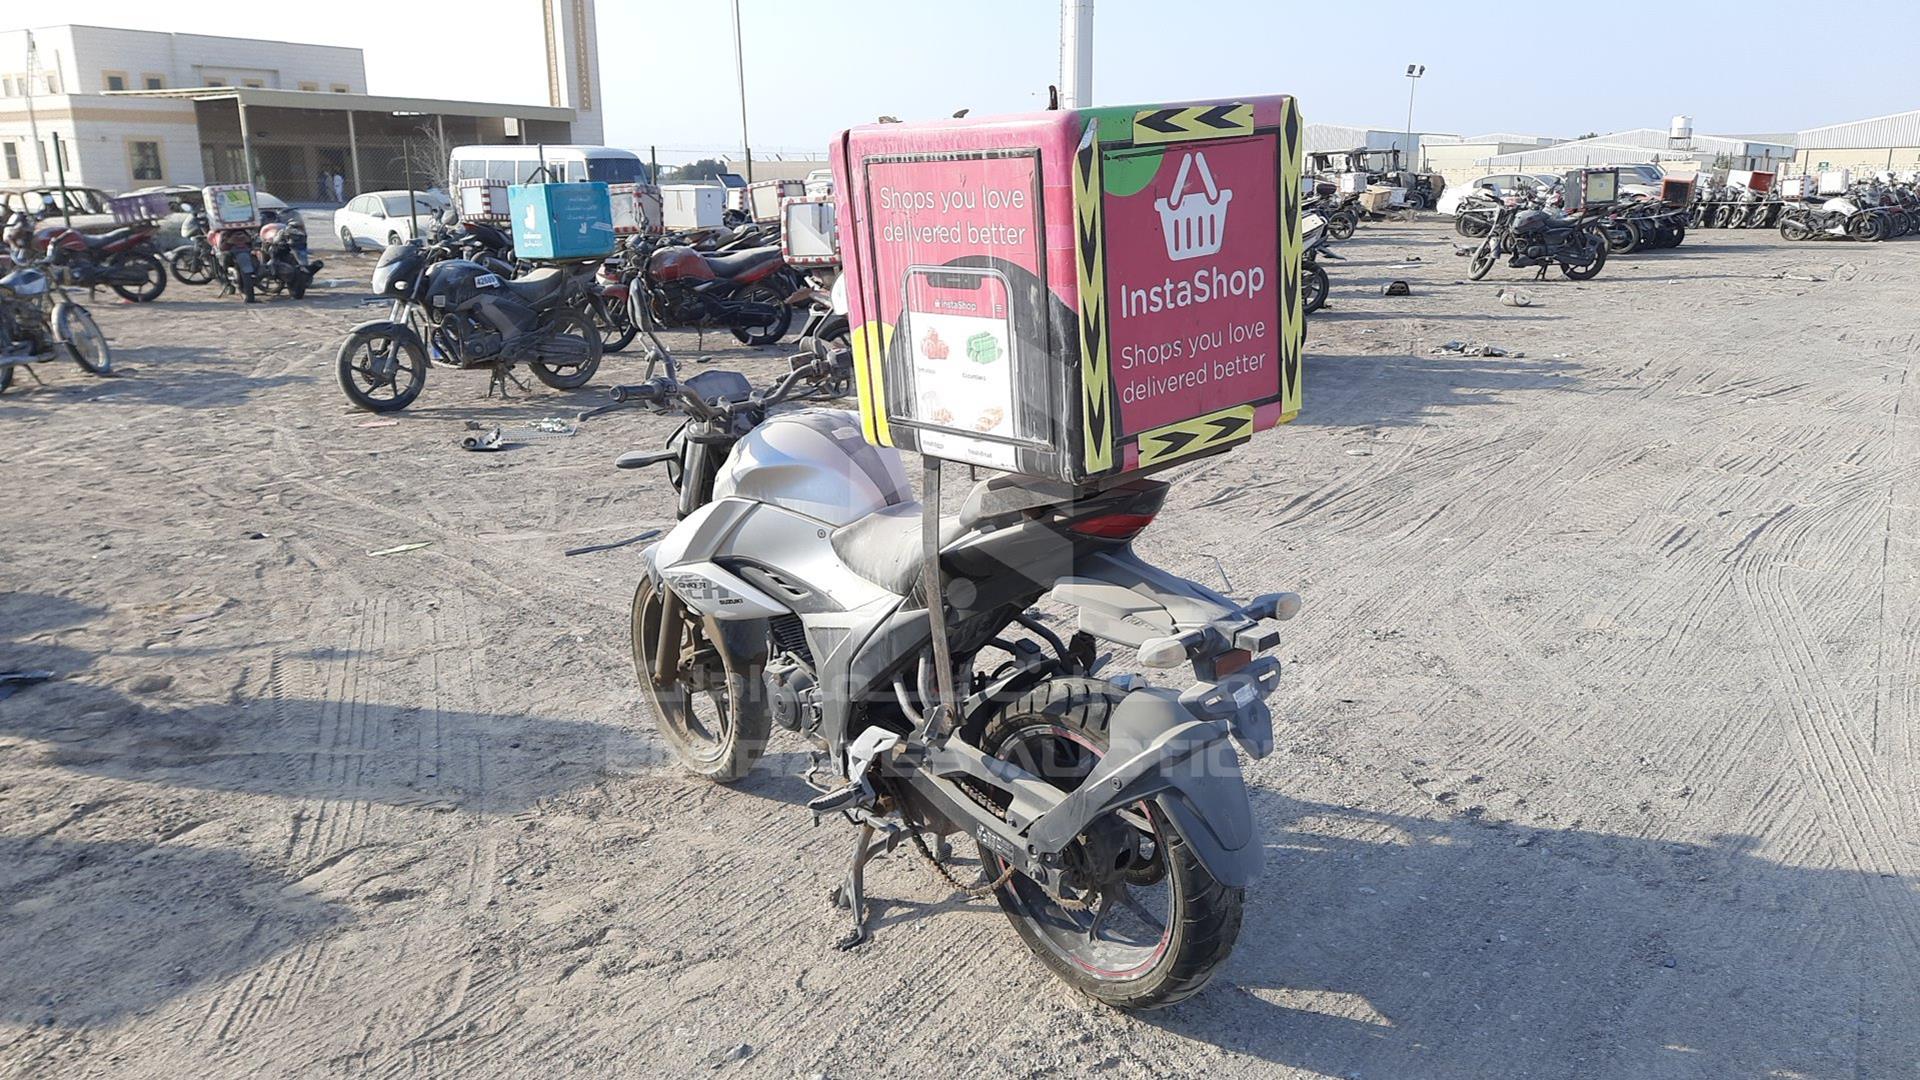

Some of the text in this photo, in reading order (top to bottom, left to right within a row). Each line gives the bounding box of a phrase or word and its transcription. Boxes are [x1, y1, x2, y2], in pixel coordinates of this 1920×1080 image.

[880, 185, 1025, 213] Shops you love
[883, 221, 1026, 244] delivered better
[1121, 266, 1265, 319] InstaShop
[1121, 321, 1265, 370] Shops you love
[1122, 352, 1266, 404] delivered better
